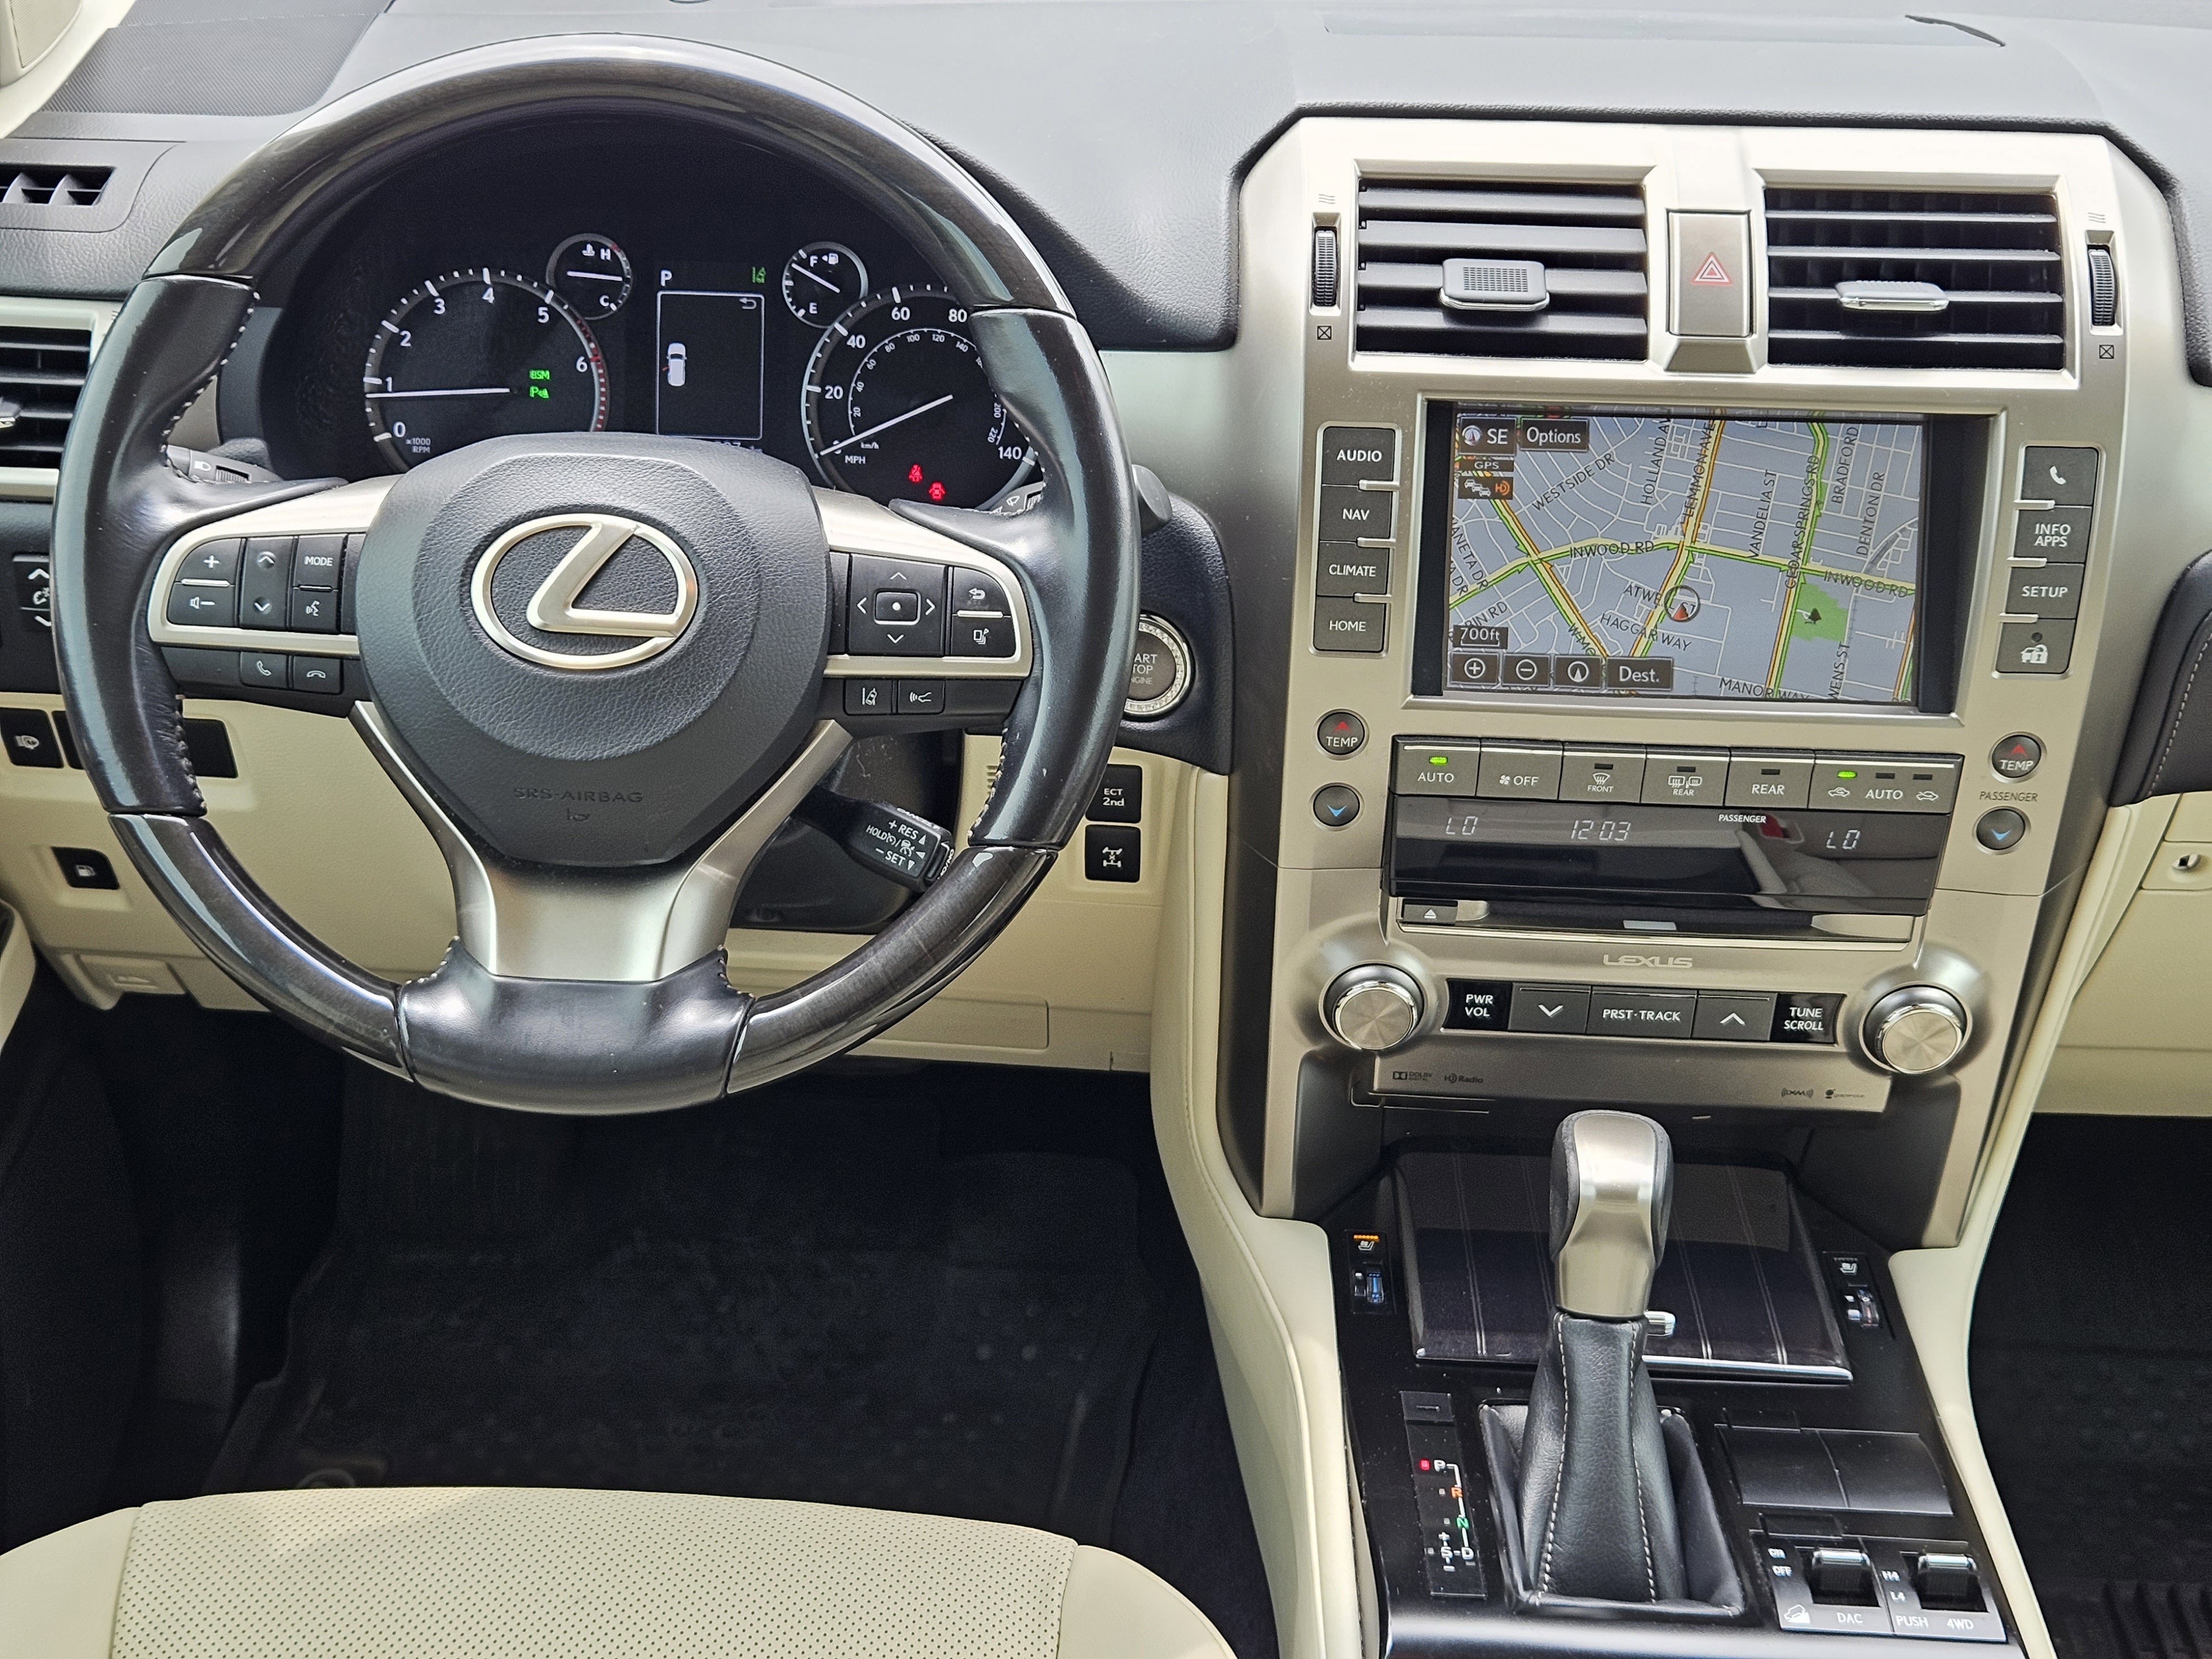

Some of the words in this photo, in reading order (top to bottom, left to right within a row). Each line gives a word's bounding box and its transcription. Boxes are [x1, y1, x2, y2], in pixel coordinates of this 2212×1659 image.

[601, 249, 611, 261] H
[810, 257, 818, 268] F
[660, 269, 673, 286] P
[483, 288, 495, 303] 4
[599, 296, 609, 307] C
[434, 299, 445, 314] 3
[809, 302, 818, 314] E
[538, 307, 549, 323] 5
[891, 307, 910, 321] 60
[948, 309, 967, 323] 80
[400, 332, 411, 347] 2
[847, 335, 866, 349] 40
[906, 333, 920, 343] 100
[932, 333, 945, 343] 120
[884, 342, 896, 353] 80
[956, 341, 969, 352] 140
[576, 357, 587, 372] 6
[865, 359, 877, 371] 60
[529, 370, 550, 380] BSM
[386, 377, 393, 392] 1
[855, 380, 865, 393] 40
[825, 385, 843, 401] 20
[853, 405, 861, 418] 20
[393, 422, 406, 438] 0
[987, 427, 998, 443] 220
[1526, 426, 1582, 445] Options
[1486, 429, 1508, 445] SE
[412, 445, 431, 453] RPM
[860, 441, 879, 450] km/h
[998, 446, 1022, 460] 140
[1337, 449, 1383, 462] AUDIO
[844, 455, 866, 465] MPH
[1474, 461, 1499, 469] GPS
[1806, 454, 1820, 476] RD
[1831, 426, 1859, 504] BRADFORD
[1640, 436, 1667, 505] HOLLAND
[1680, 450, 1708, 524] LEMMON
[1699, 421, 1717, 451] AVE
[1532, 467, 1595, 512] WESTSIDE
[1594, 452, 1616, 471] DR
[1793, 477, 1815, 536] SPRINGS
[1342, 508, 1370, 521] NAV
[1746, 487, 1773, 559] VANDELIA
[1763, 469, 1777, 487] ST
[1856, 491, 1882, 556] DENTON
[1870, 471, 1885, 492] DR
[2034, 523, 2071, 536] INFO
[2034, 535, 2068, 547] APPS
[1569, 543, 1630, 559] INWOOD
[1633, 540, 1655, 553] RD
[304, 556, 333, 567] MODE
[1785, 540, 1804, 589] CEDAR
[1328, 564, 1376, 577] CLIMATE
[1452, 575, 1469, 597] DR
[1472, 570, 1489, 591] DR
[1823, 570, 1885, 593] INWOOD
[1888, 583, 1908, 597] RD
[2021, 585, 2068, 598] SETUP
[1488, 601, 1508, 619] RD
[1329, 619, 1366, 632] HOME
[1602, 613, 1658, 642] HAGGAR
[1661, 632, 1692, 651] WAY
[1460, 628, 1500, 640] 700ft
[1836, 641, 1850, 658] ST
[1134, 653, 1157, 664] ART
[1133, 664, 1154, 674] TOP
[1619, 666, 1660, 682] Dest.
[1719, 677, 1775, 698] MANOR
[1326, 735, 1358, 748] TEMP
[1999, 759, 2034, 771] TEMP
[1417, 773, 1454, 784] AUTO
[1513, 775, 1539, 786] OFF
[1587, 785, 1614, 793] FRONT
[1751, 784, 1785, 795] REAR
[1865, 789, 1904, 800] AUTO
[1102, 797, 1125, 807] 2nd
[1979, 791, 2038, 802] PASSENGER
[1718, 813, 1767, 824] PASSENGER
[866, 824, 888, 842] HOLD
[898, 823, 919, 840] RES
[885, 850, 906, 867] SET
[1603, 954, 1693, 969] LEXUS
[1465, 994, 1493, 1005] PWR
[1465, 1006, 1490, 1018] VOL
[1790, 1007, 1822, 1018] TUNE
[1784, 1020, 1824, 1031] SCROLL
[1434, 1459, 1446, 1472] P
[1451, 1487, 1463, 1498] R
[1457, 1517, 1469, 1529] N
[1441, 1546, 1453, 1559] S
[1461, 1547, 1474, 1560] D
[1768, 1548, 1786, 1559] ON
[1772, 1566, 1792, 1577] OFF
[1881, 1570, 1900, 1582] H4
[1890, 1591, 1906, 1602] L4
[1837, 1612, 1863, 1624] DAC
[1895, 1614, 1928, 1629] PUSH
[1946, 1618, 1974, 1630] 4WD
